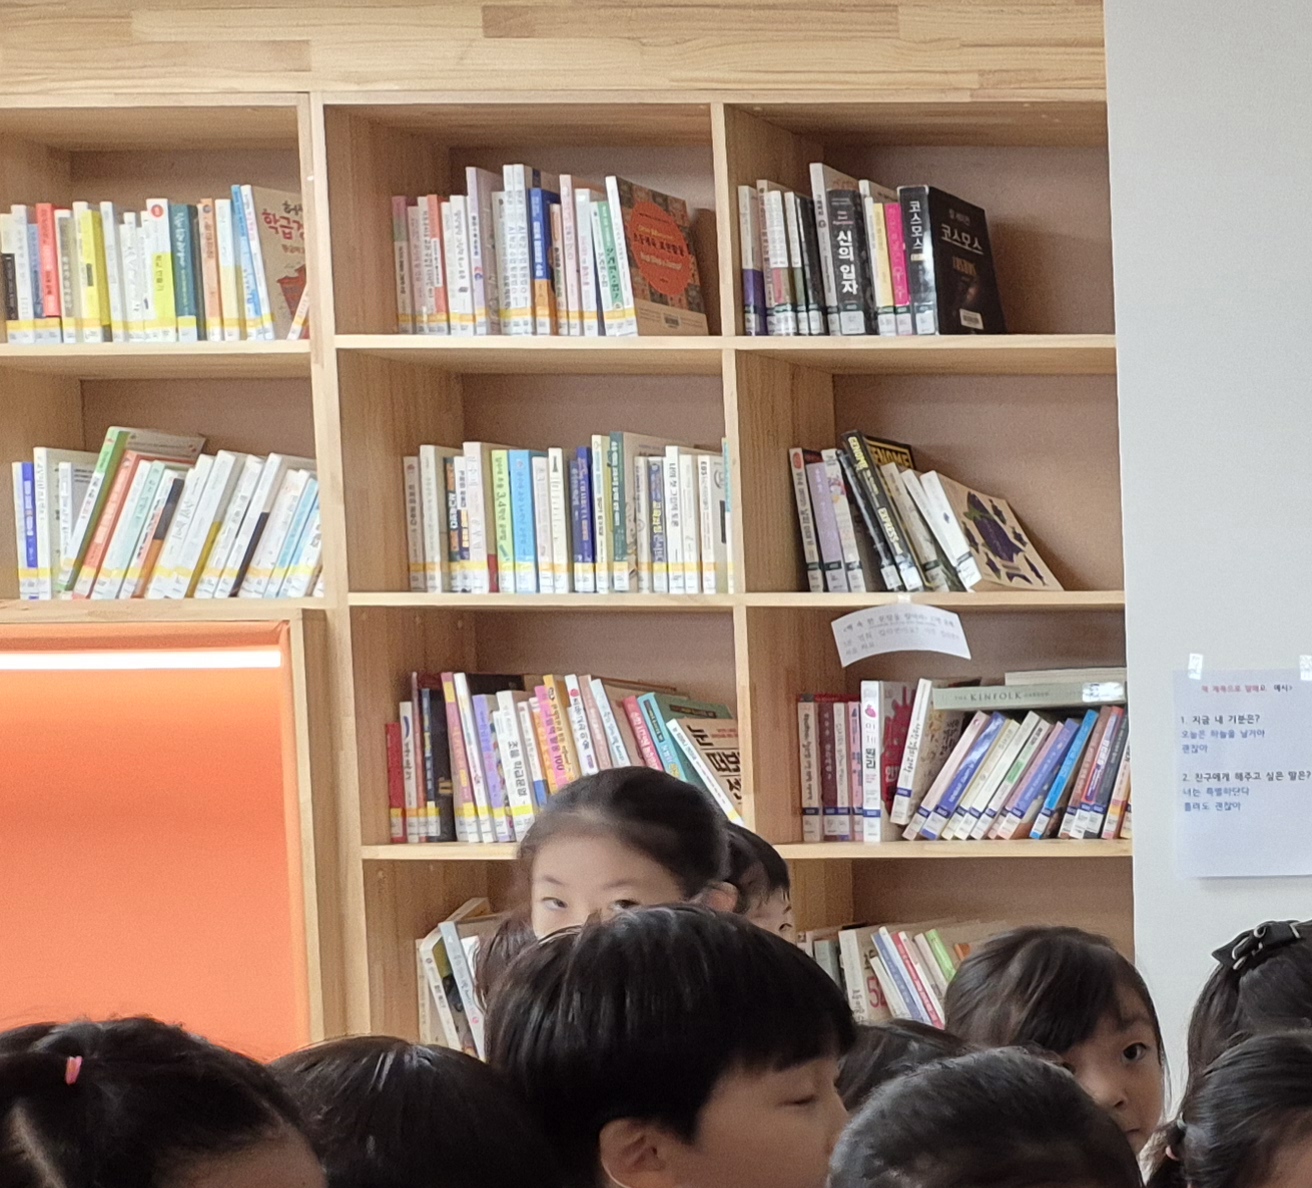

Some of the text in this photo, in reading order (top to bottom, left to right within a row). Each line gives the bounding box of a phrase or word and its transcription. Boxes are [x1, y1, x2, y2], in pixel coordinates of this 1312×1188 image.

[909, 200, 923, 250] 코스모스
[837, 229, 855, 262] 신의
[941, 223, 985, 255] 코스모스
[839, 263, 859, 295] 입자
[871, 446, 911, 468] ENOME
[848, 436, 900, 545] GENOME EXPRESS
[970, 692, 1022, 701] KINFOLK
[1192, 715, 1210, 725] 지금
[1215, 715, 1224, 724] 내
[1228, 714, 1261, 725] 기분은?
[1182, 730, 1206, 740] 오늘은
[1182, 744, 1208, 754] 괜찮아
[1195, 773, 1231, 783] 친구에게
[1235, 772, 1261, 782] 해주고
[1266, 772, 1284, 782] 싶은
[1288, 771, 1312, 781] 말은?
[1215, 802, 1241, 811] 괜찮아
